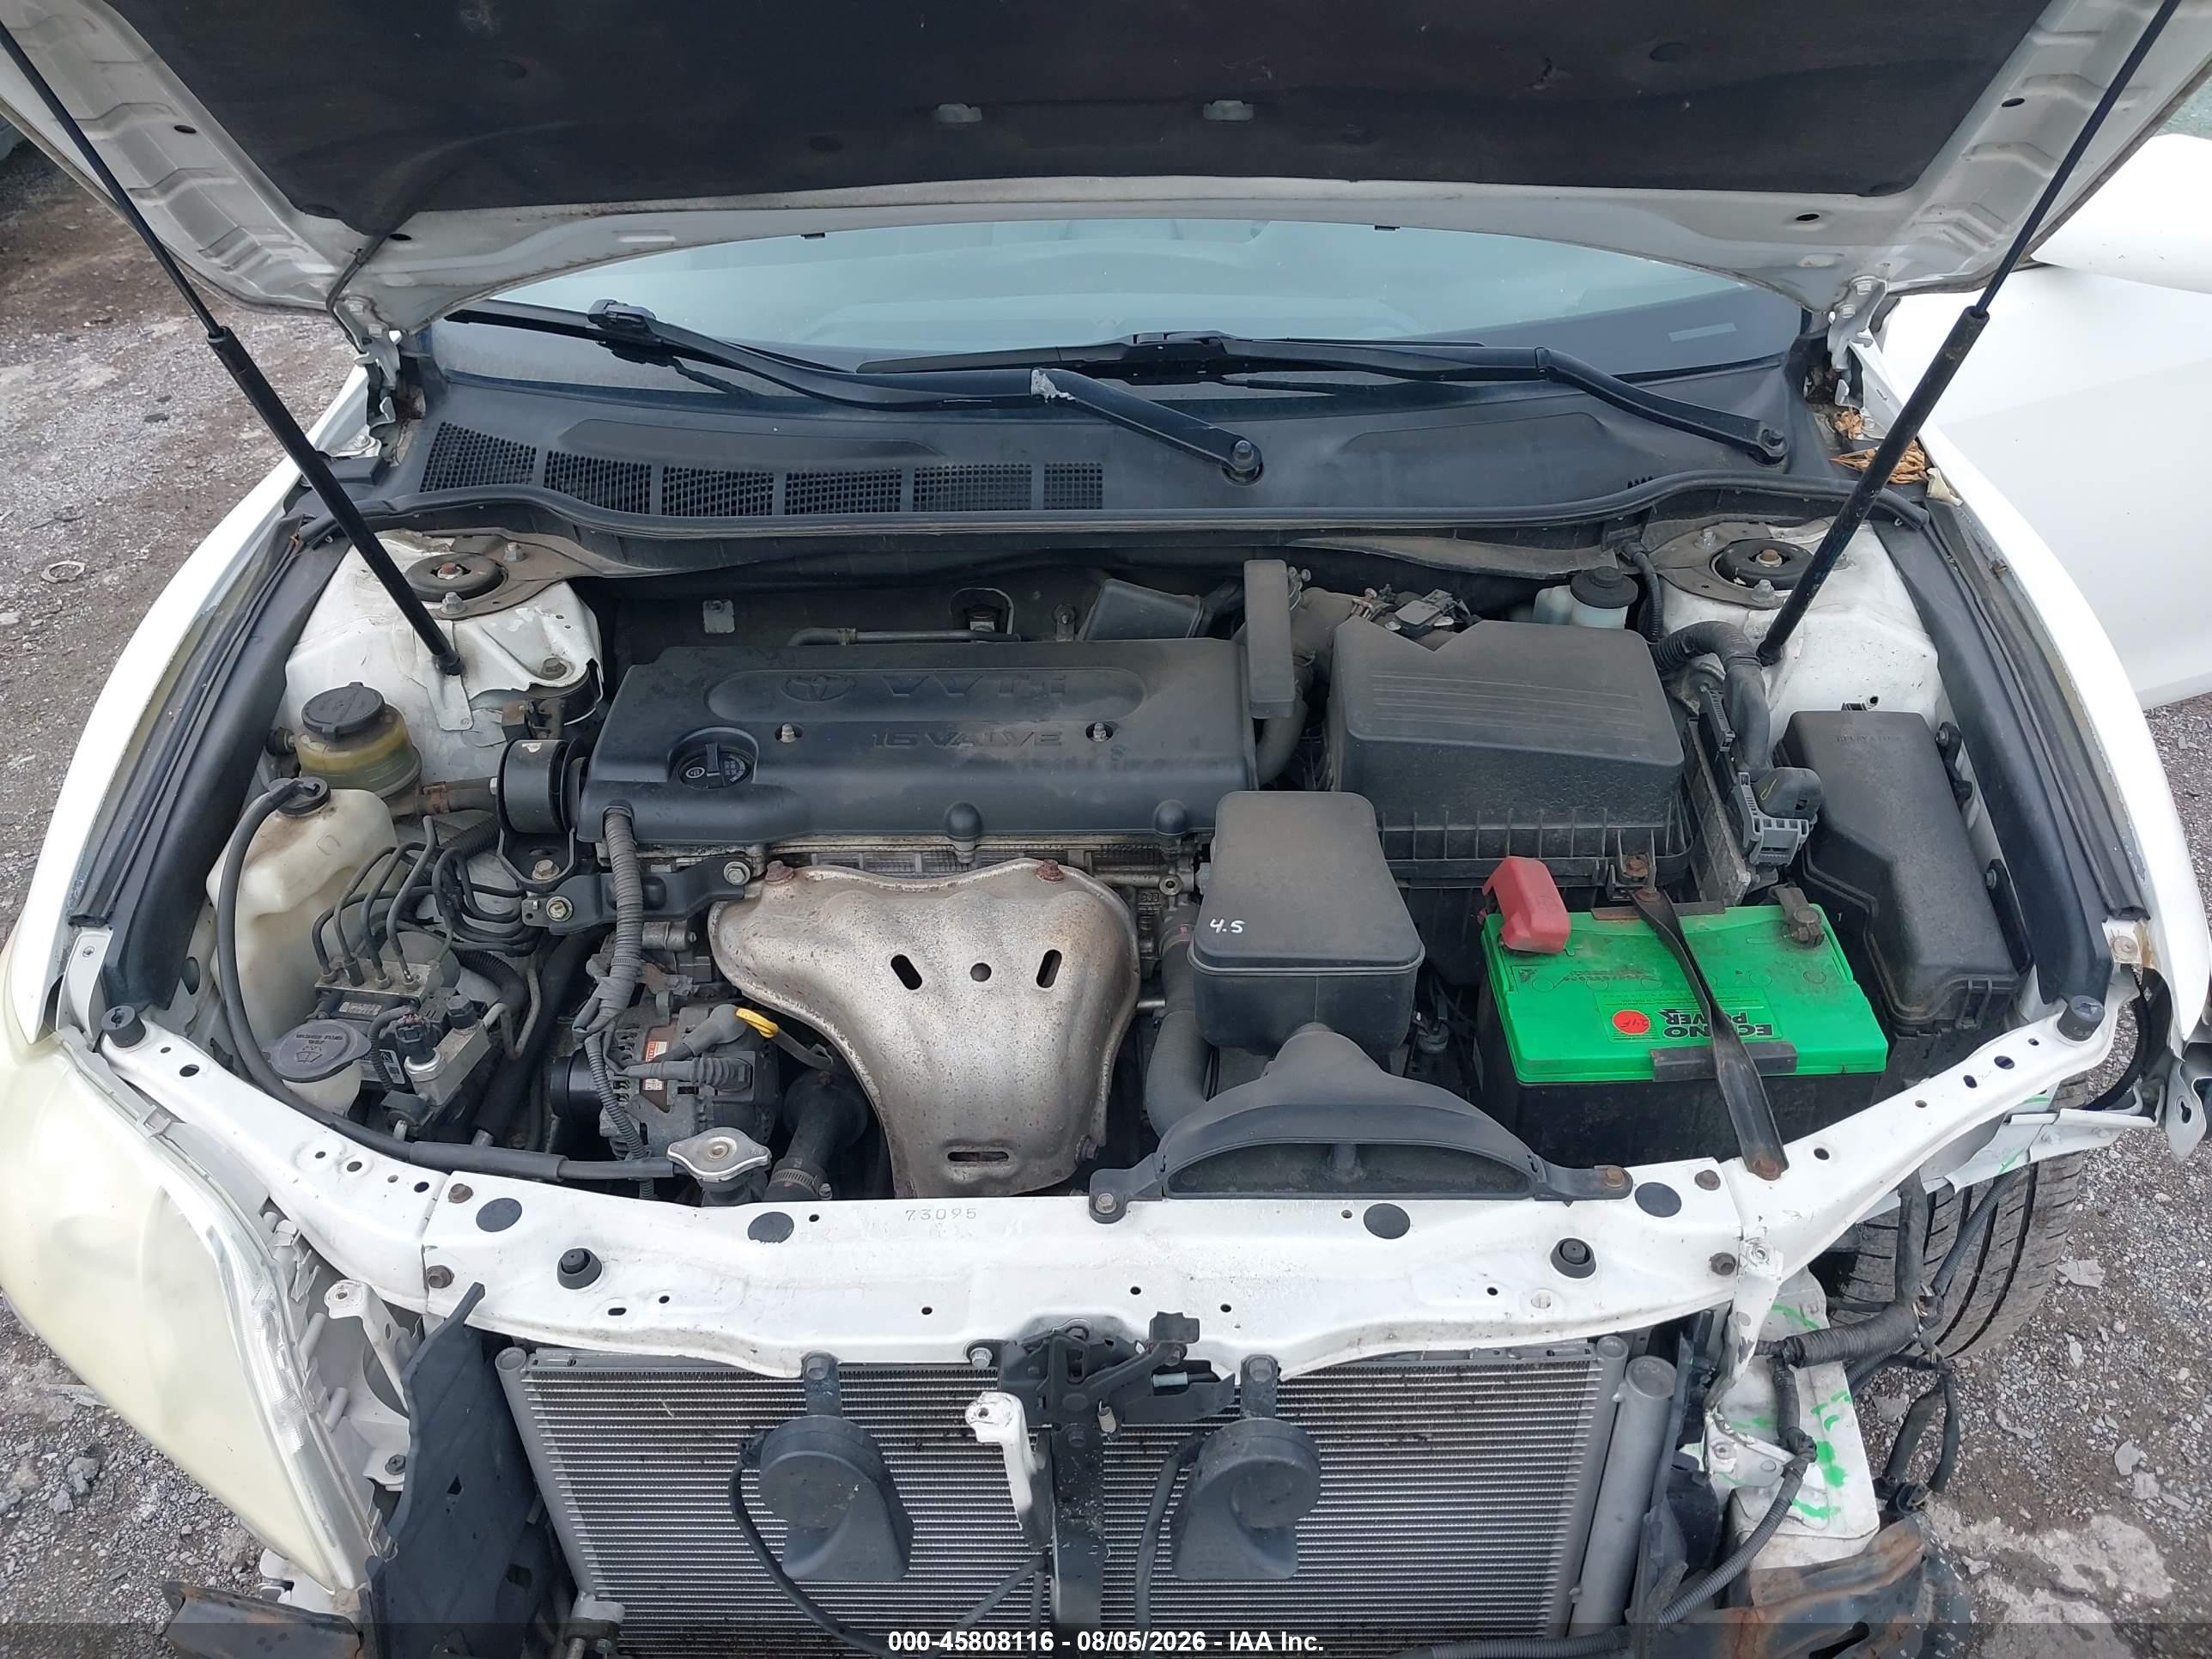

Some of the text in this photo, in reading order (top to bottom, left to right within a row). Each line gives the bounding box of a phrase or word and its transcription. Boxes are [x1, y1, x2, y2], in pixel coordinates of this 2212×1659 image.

[1210, 918, 1246, 934] 4.5
[1658, 1010, 1748, 1024] PWER
[1663, 1024, 1773, 1038] ECNO
[905, 1208, 976, 1221] 73095
